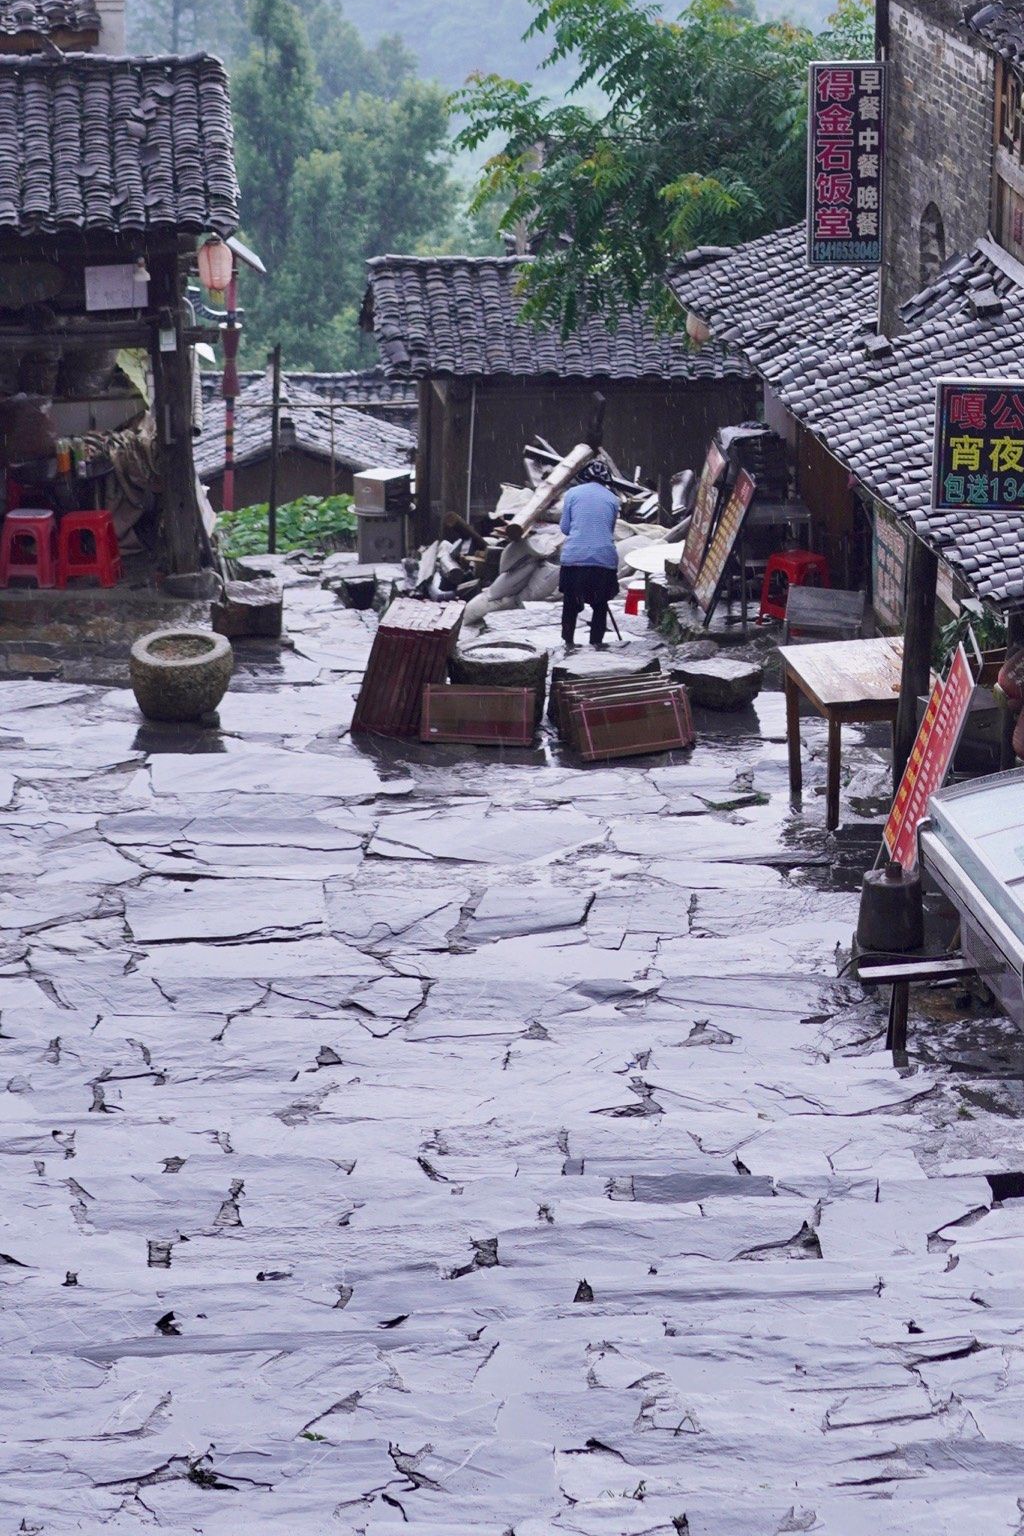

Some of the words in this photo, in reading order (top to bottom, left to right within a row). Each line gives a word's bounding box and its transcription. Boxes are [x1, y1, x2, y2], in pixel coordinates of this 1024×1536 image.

[858, 70, 881, 120] 早餐
[815, 69, 855, 239] 得金石饭堂
[857, 127, 879, 178] 中餐
[856, 186, 878, 237] 晚餐
